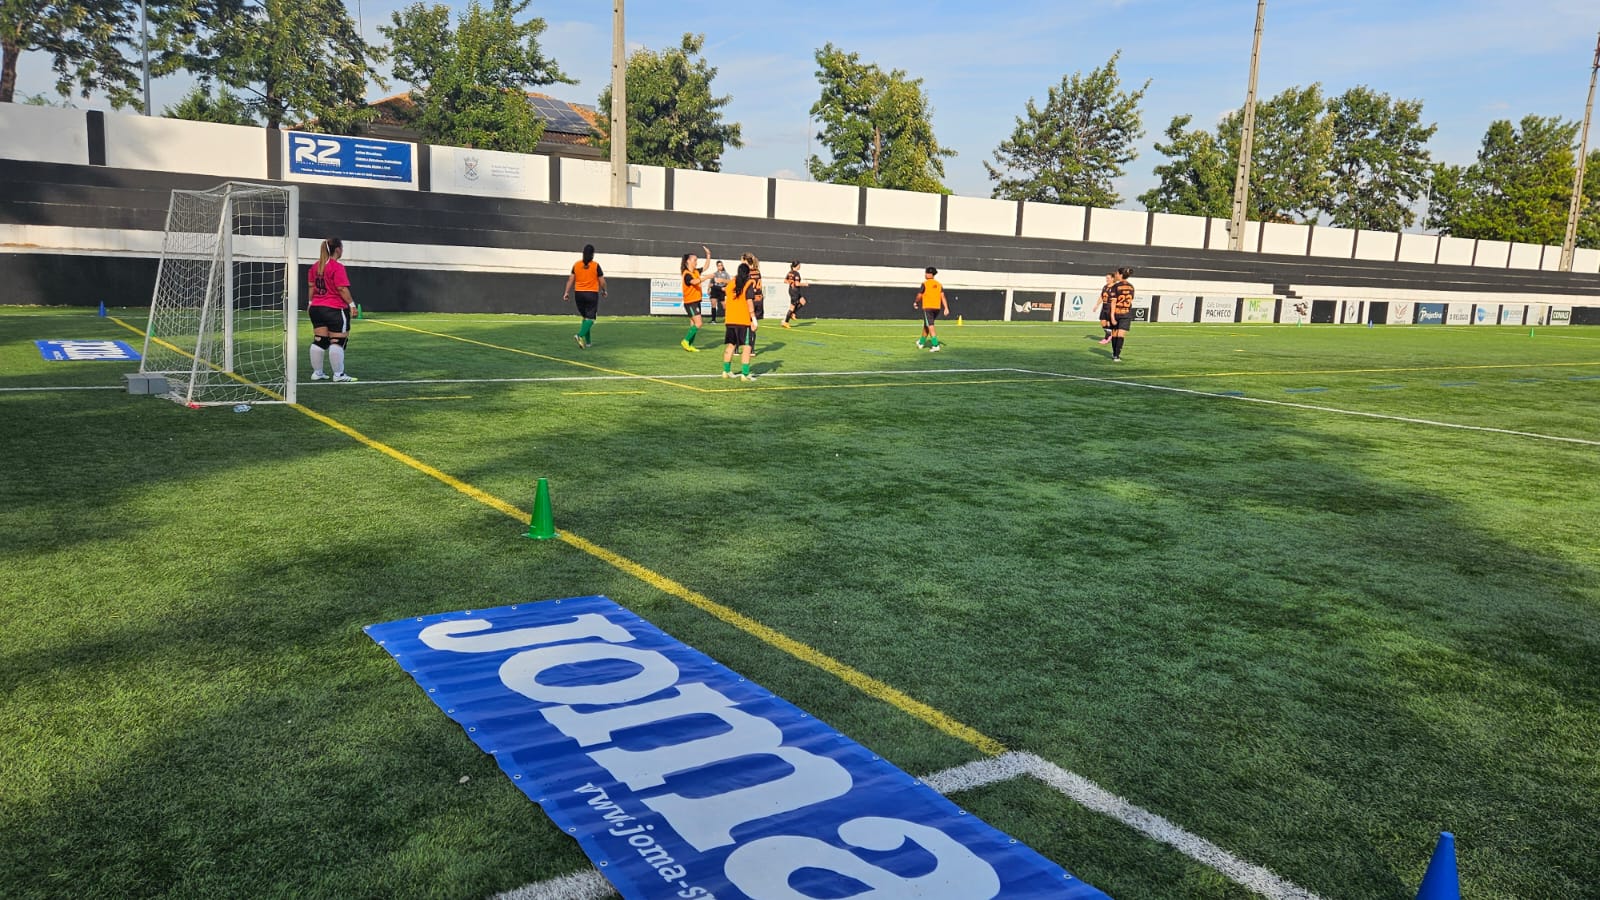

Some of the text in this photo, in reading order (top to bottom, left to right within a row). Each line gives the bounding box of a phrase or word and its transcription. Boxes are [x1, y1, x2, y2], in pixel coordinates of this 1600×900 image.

[294, 137, 341, 166] R2
[1116, 295, 1133, 308] 23
[1205, 309, 1231, 318] PACHECO
